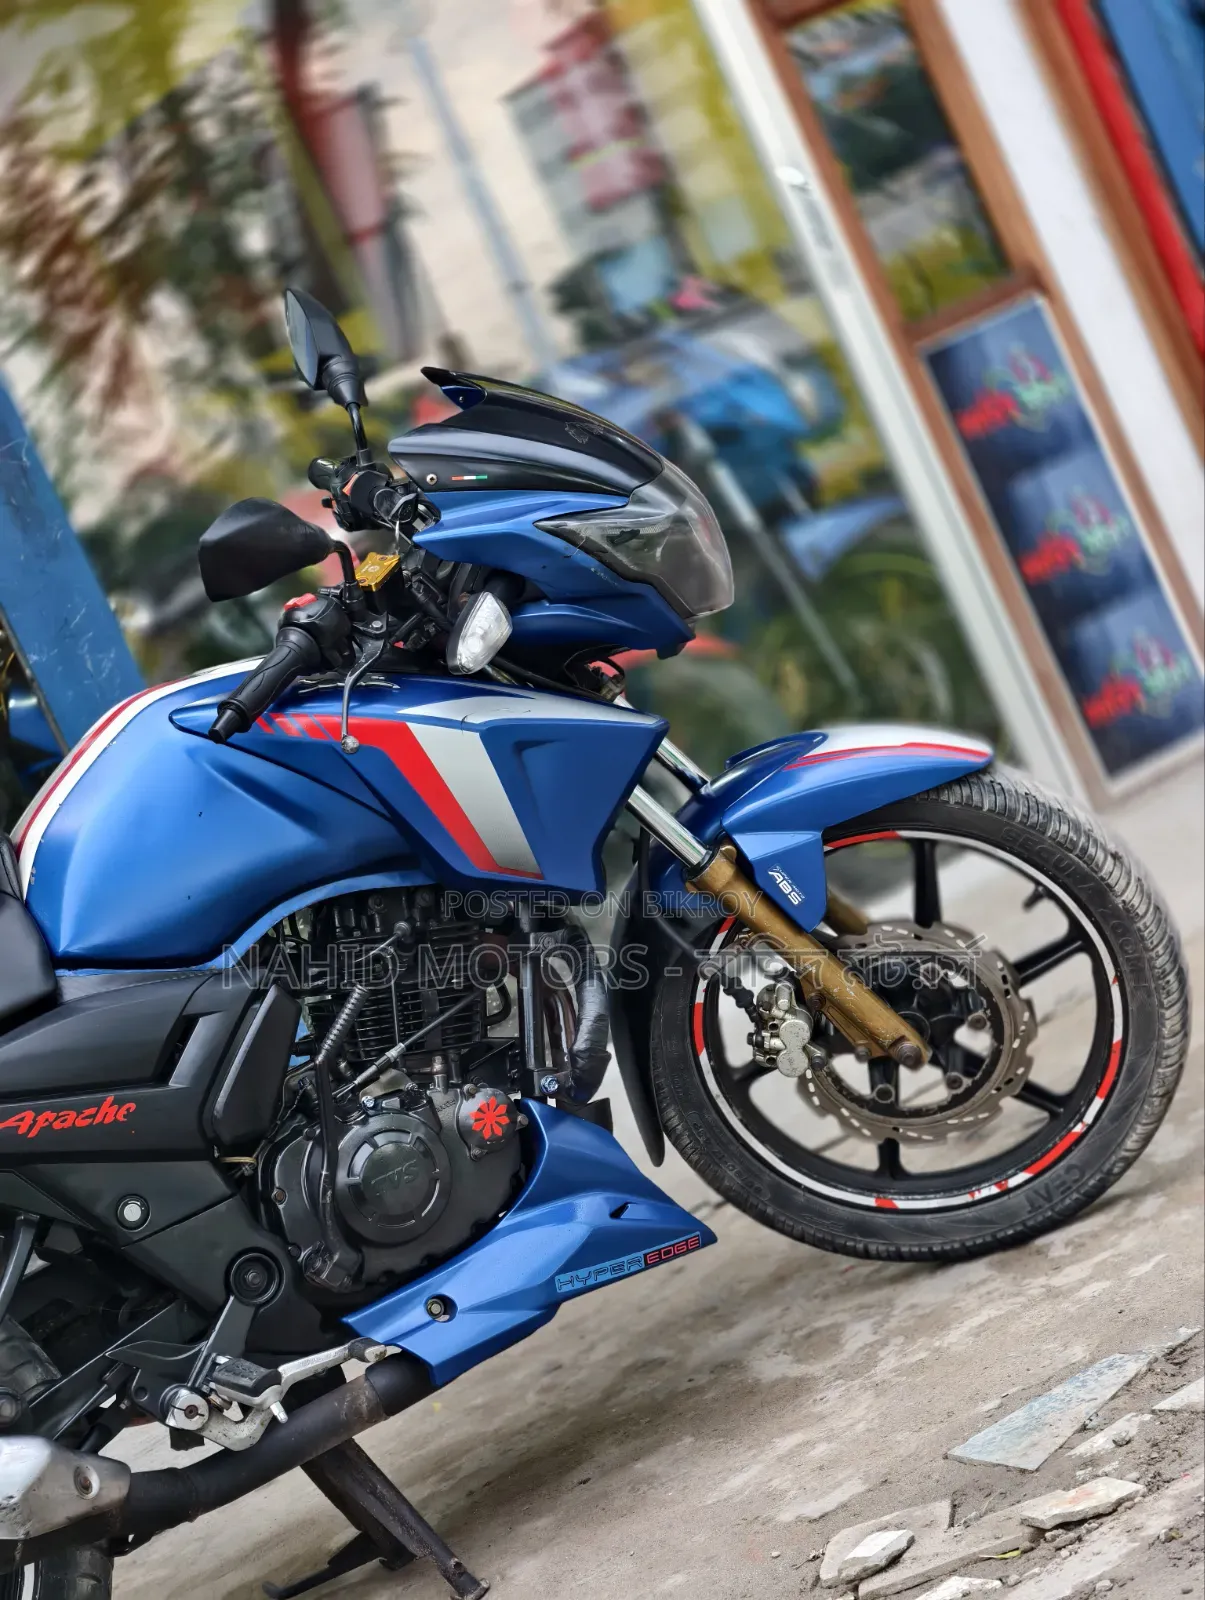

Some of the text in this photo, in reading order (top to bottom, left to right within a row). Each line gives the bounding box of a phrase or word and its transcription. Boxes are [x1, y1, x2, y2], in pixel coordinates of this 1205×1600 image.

[767, 870, 802, 905] ABS
[0, 1095, 136, 1138] Apache
[1024, 1163, 1086, 1215] CEAT
[556, 1236, 700, 1291] HYPER EDGE
